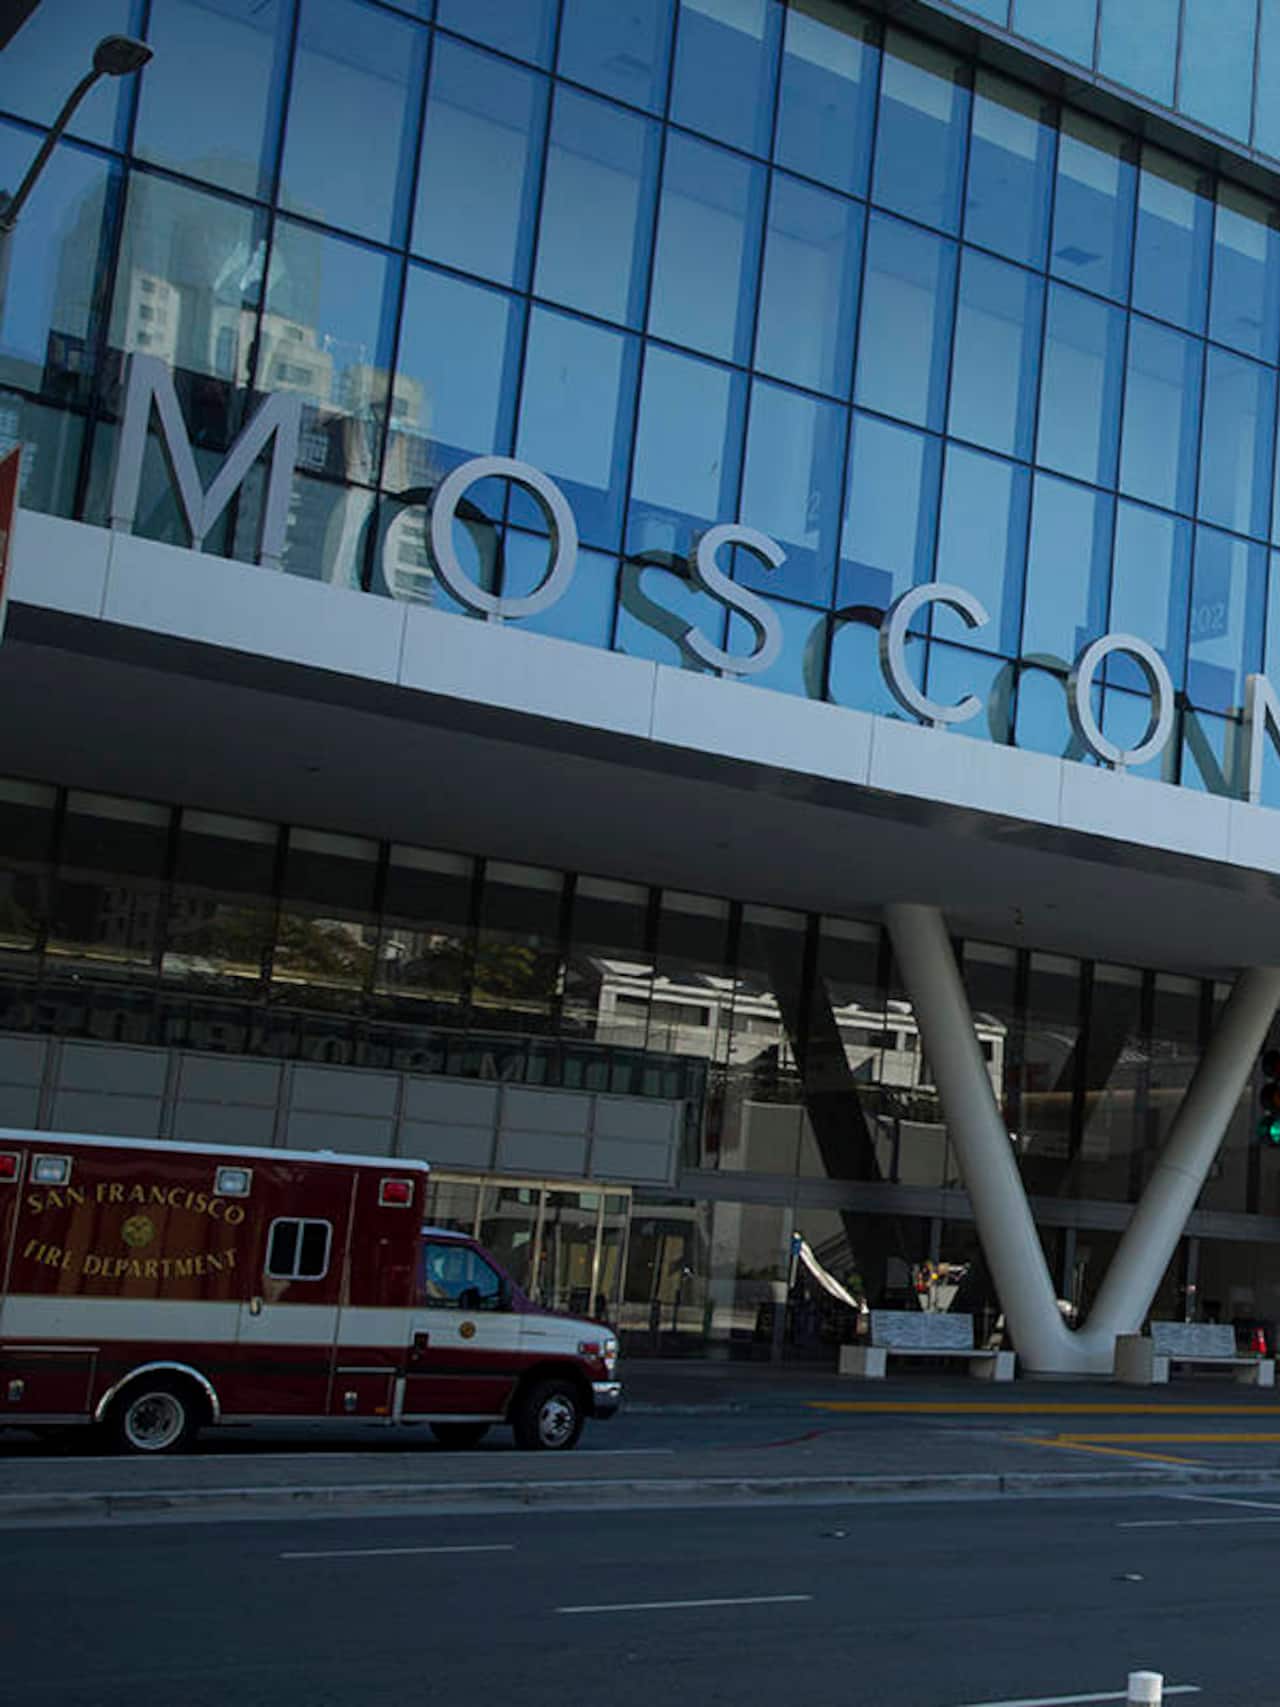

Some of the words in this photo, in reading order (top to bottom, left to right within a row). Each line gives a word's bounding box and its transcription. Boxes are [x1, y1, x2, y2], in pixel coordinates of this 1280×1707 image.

[27, 1186, 85, 1214] SAN
[96, 1182, 246, 1225] FRANCISCO
[23, 1239, 73, 1269] FIRE
[83, 1248, 239, 1280] DEPARTMENT
